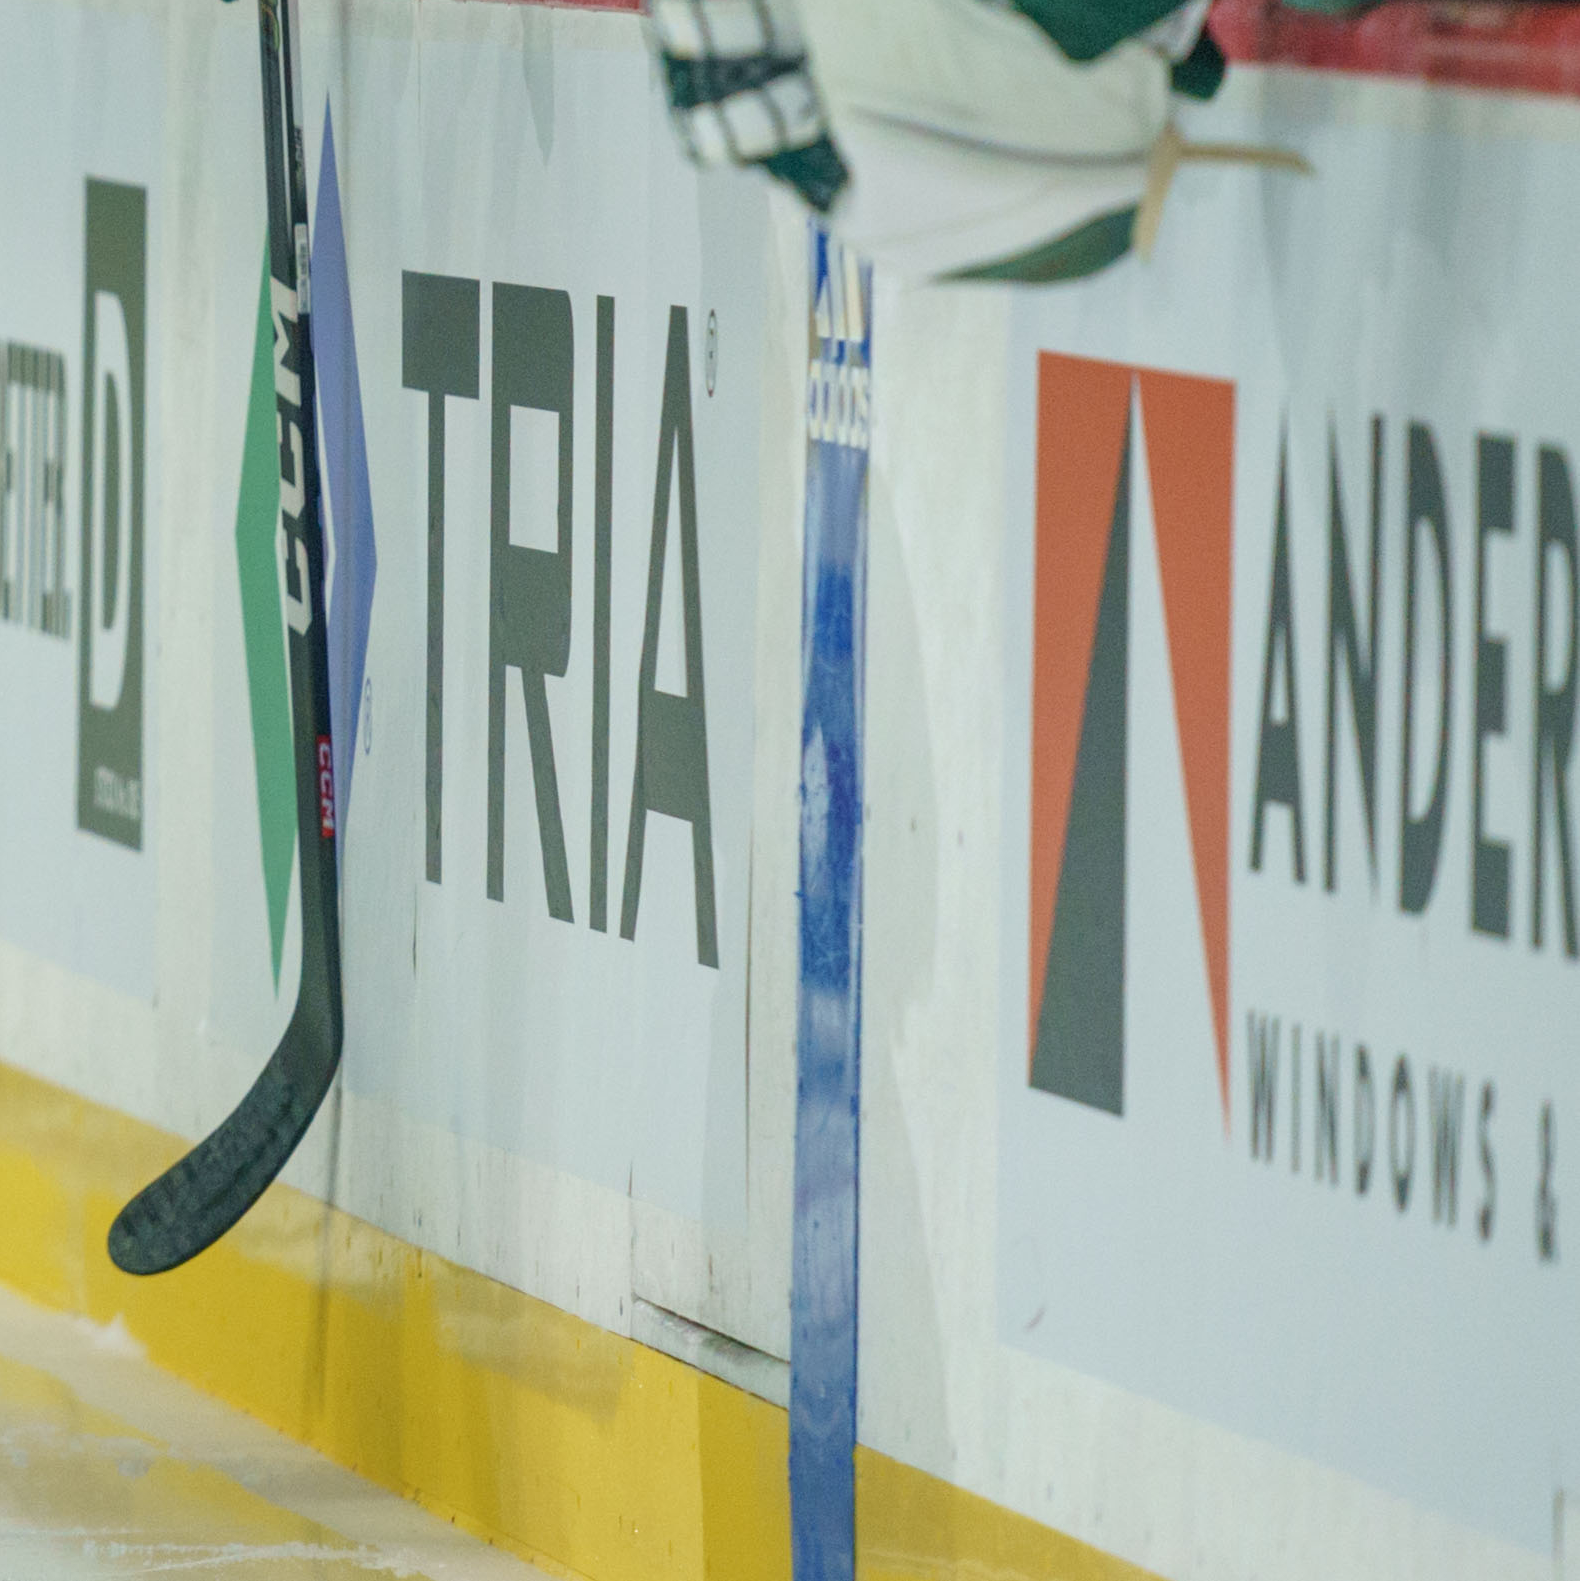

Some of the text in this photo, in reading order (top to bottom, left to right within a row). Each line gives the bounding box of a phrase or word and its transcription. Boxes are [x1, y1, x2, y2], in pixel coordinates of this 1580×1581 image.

[270, 275, 314, 637] CCM
[400, 268, 720, 972] TRIA
[318, 741, 336, 830] CCM
[1249, 405, 1580, 965] ANDER
[1246, 1008, 1499, 1246] WINDOWS
